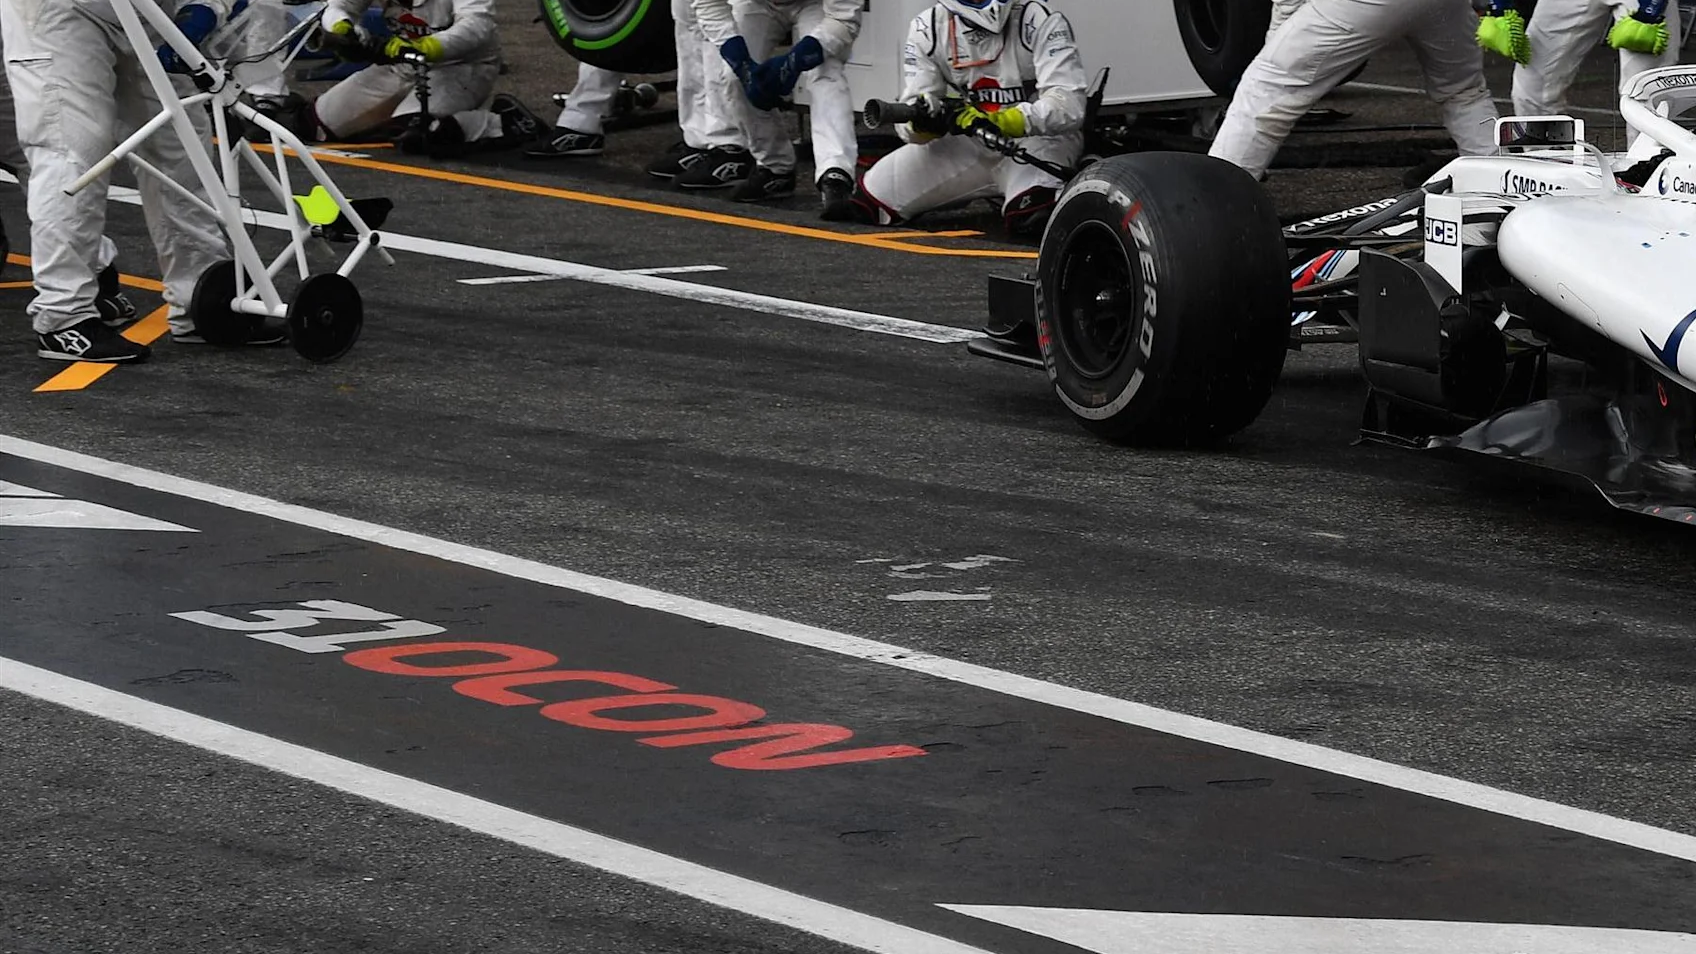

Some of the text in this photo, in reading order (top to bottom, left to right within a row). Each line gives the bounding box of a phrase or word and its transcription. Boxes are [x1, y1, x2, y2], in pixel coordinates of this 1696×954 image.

[1302, 194, 1397, 228] Rexona
[1426, 216, 1457, 245] JCB
[342, 641, 929, 771] OCON
